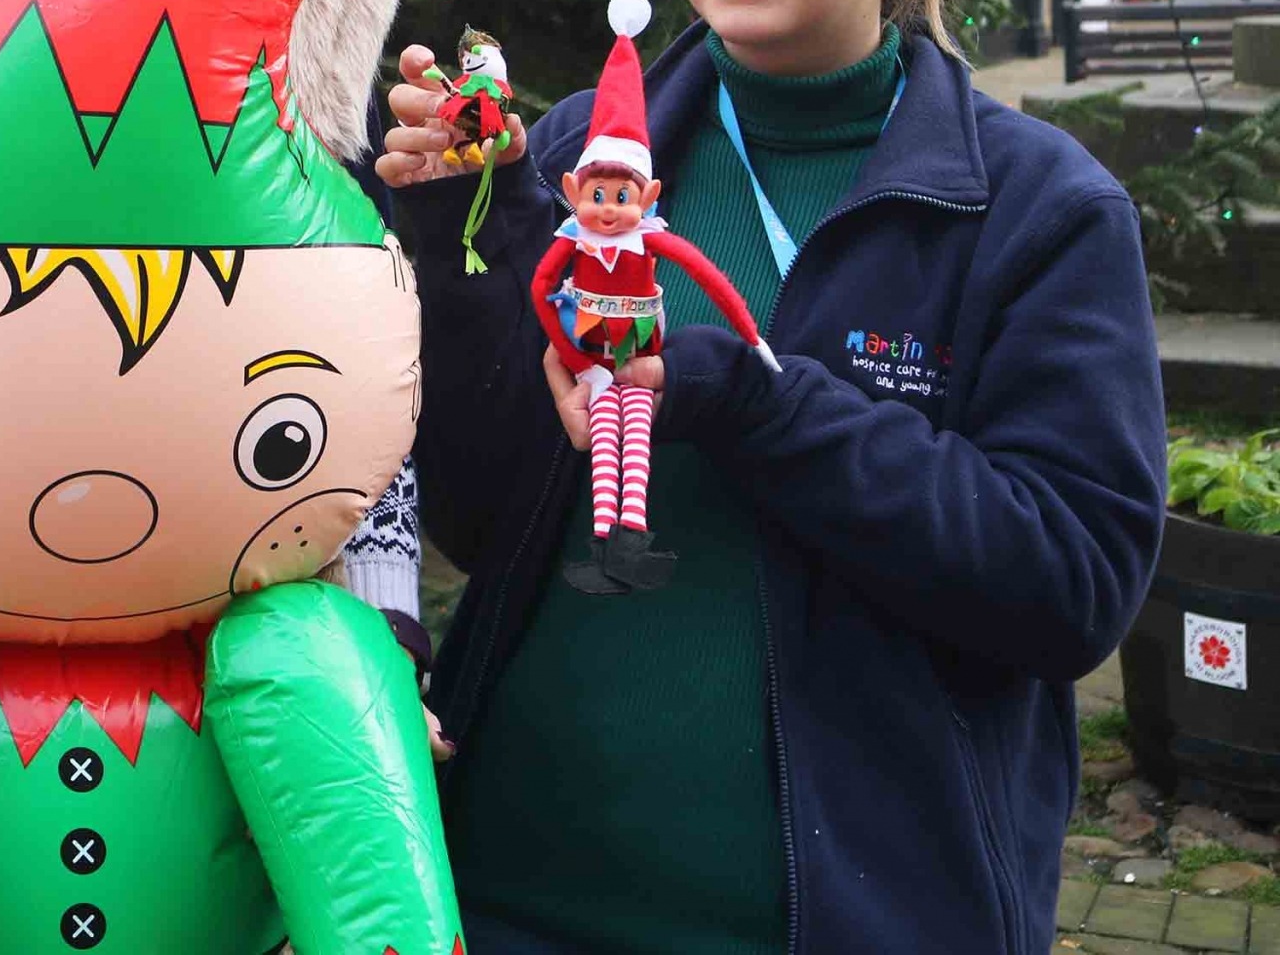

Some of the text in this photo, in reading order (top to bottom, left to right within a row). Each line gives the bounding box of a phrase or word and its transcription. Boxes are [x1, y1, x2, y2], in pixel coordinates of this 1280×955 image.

[573, 290, 657, 312] Martn Houe
[846, 330, 923, 360] Martin
[852, 355, 891, 373] hospice
[896, 365, 921, 377] care
[876, 376, 895, 388] and
[900, 381, 931, 396] young
